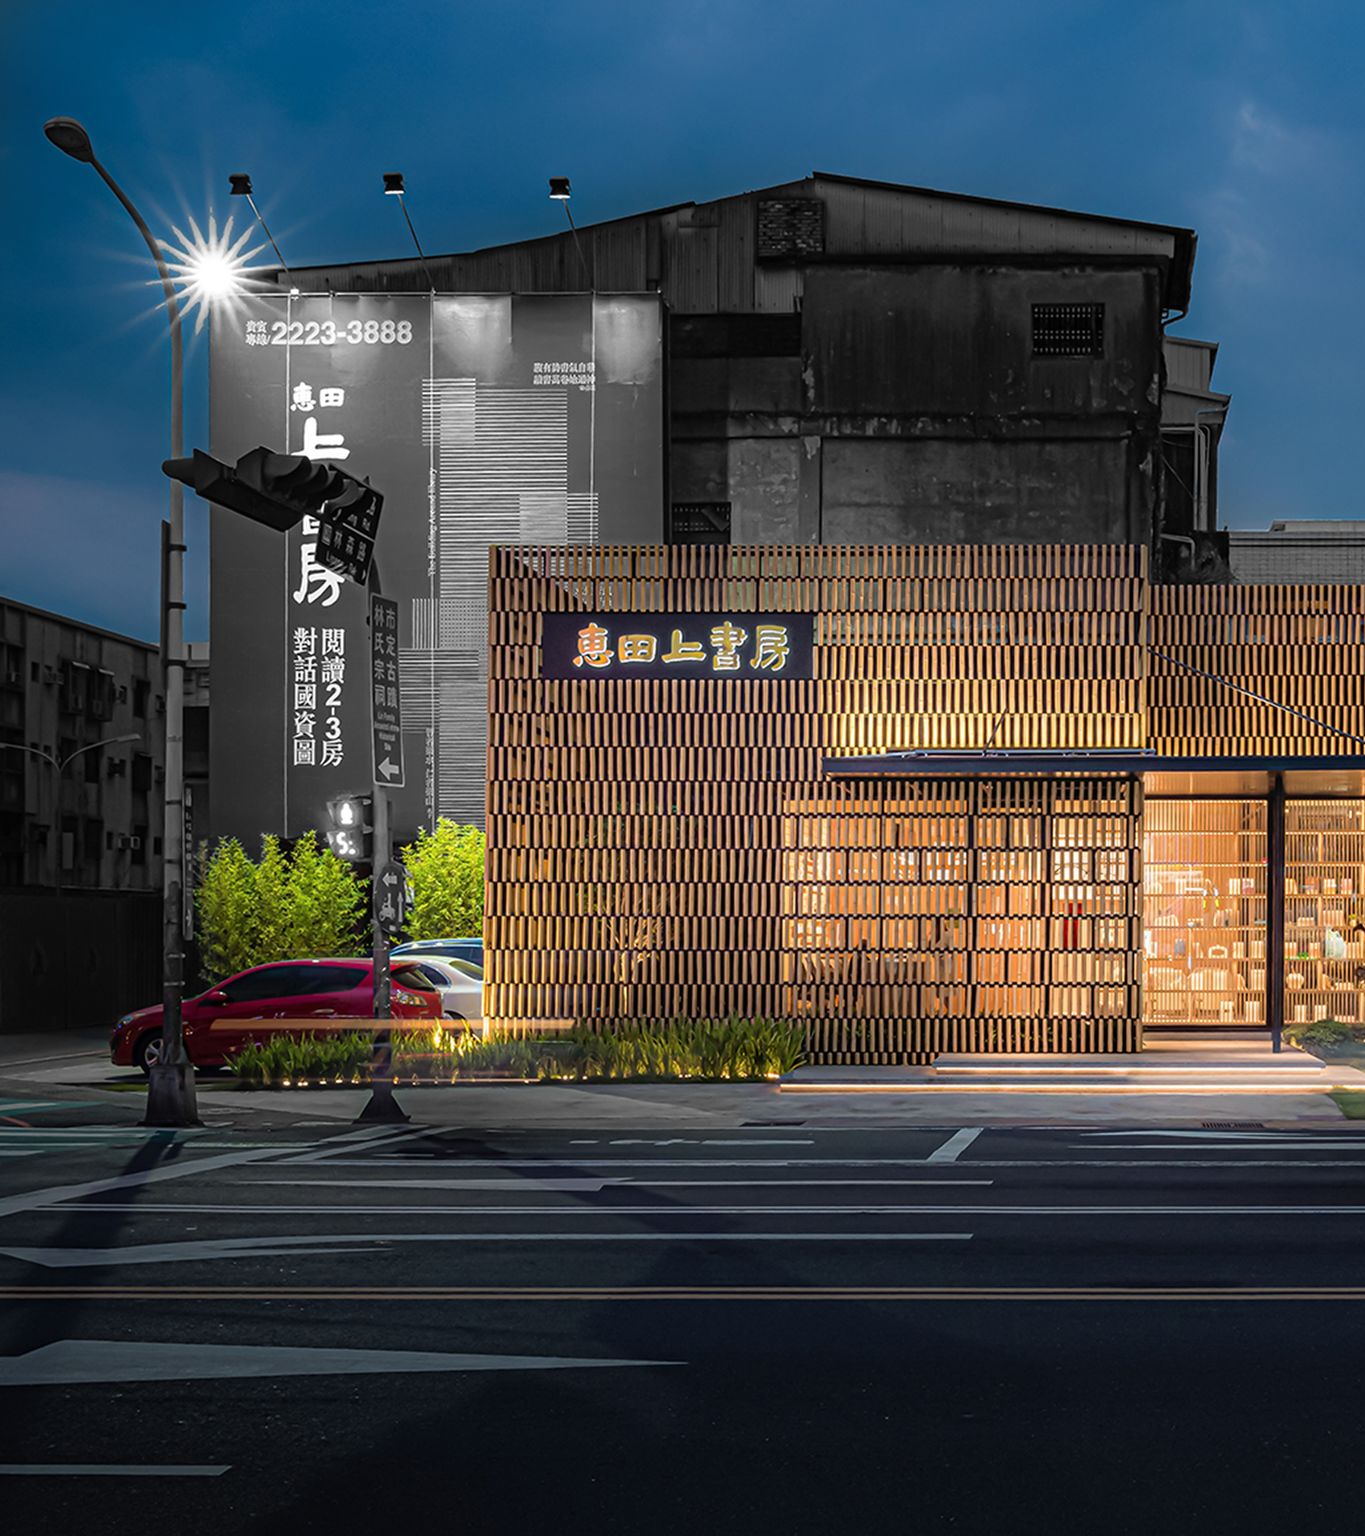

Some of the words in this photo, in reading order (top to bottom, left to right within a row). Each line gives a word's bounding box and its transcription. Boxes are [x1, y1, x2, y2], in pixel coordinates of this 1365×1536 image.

[271, 320, 413, 345] 2223-3888
[572, 621, 790, 671] 惠田上書房
[292, 626, 318, 766] 對話國資圖
[320, 628, 345, 767] 閱讀2-3房
